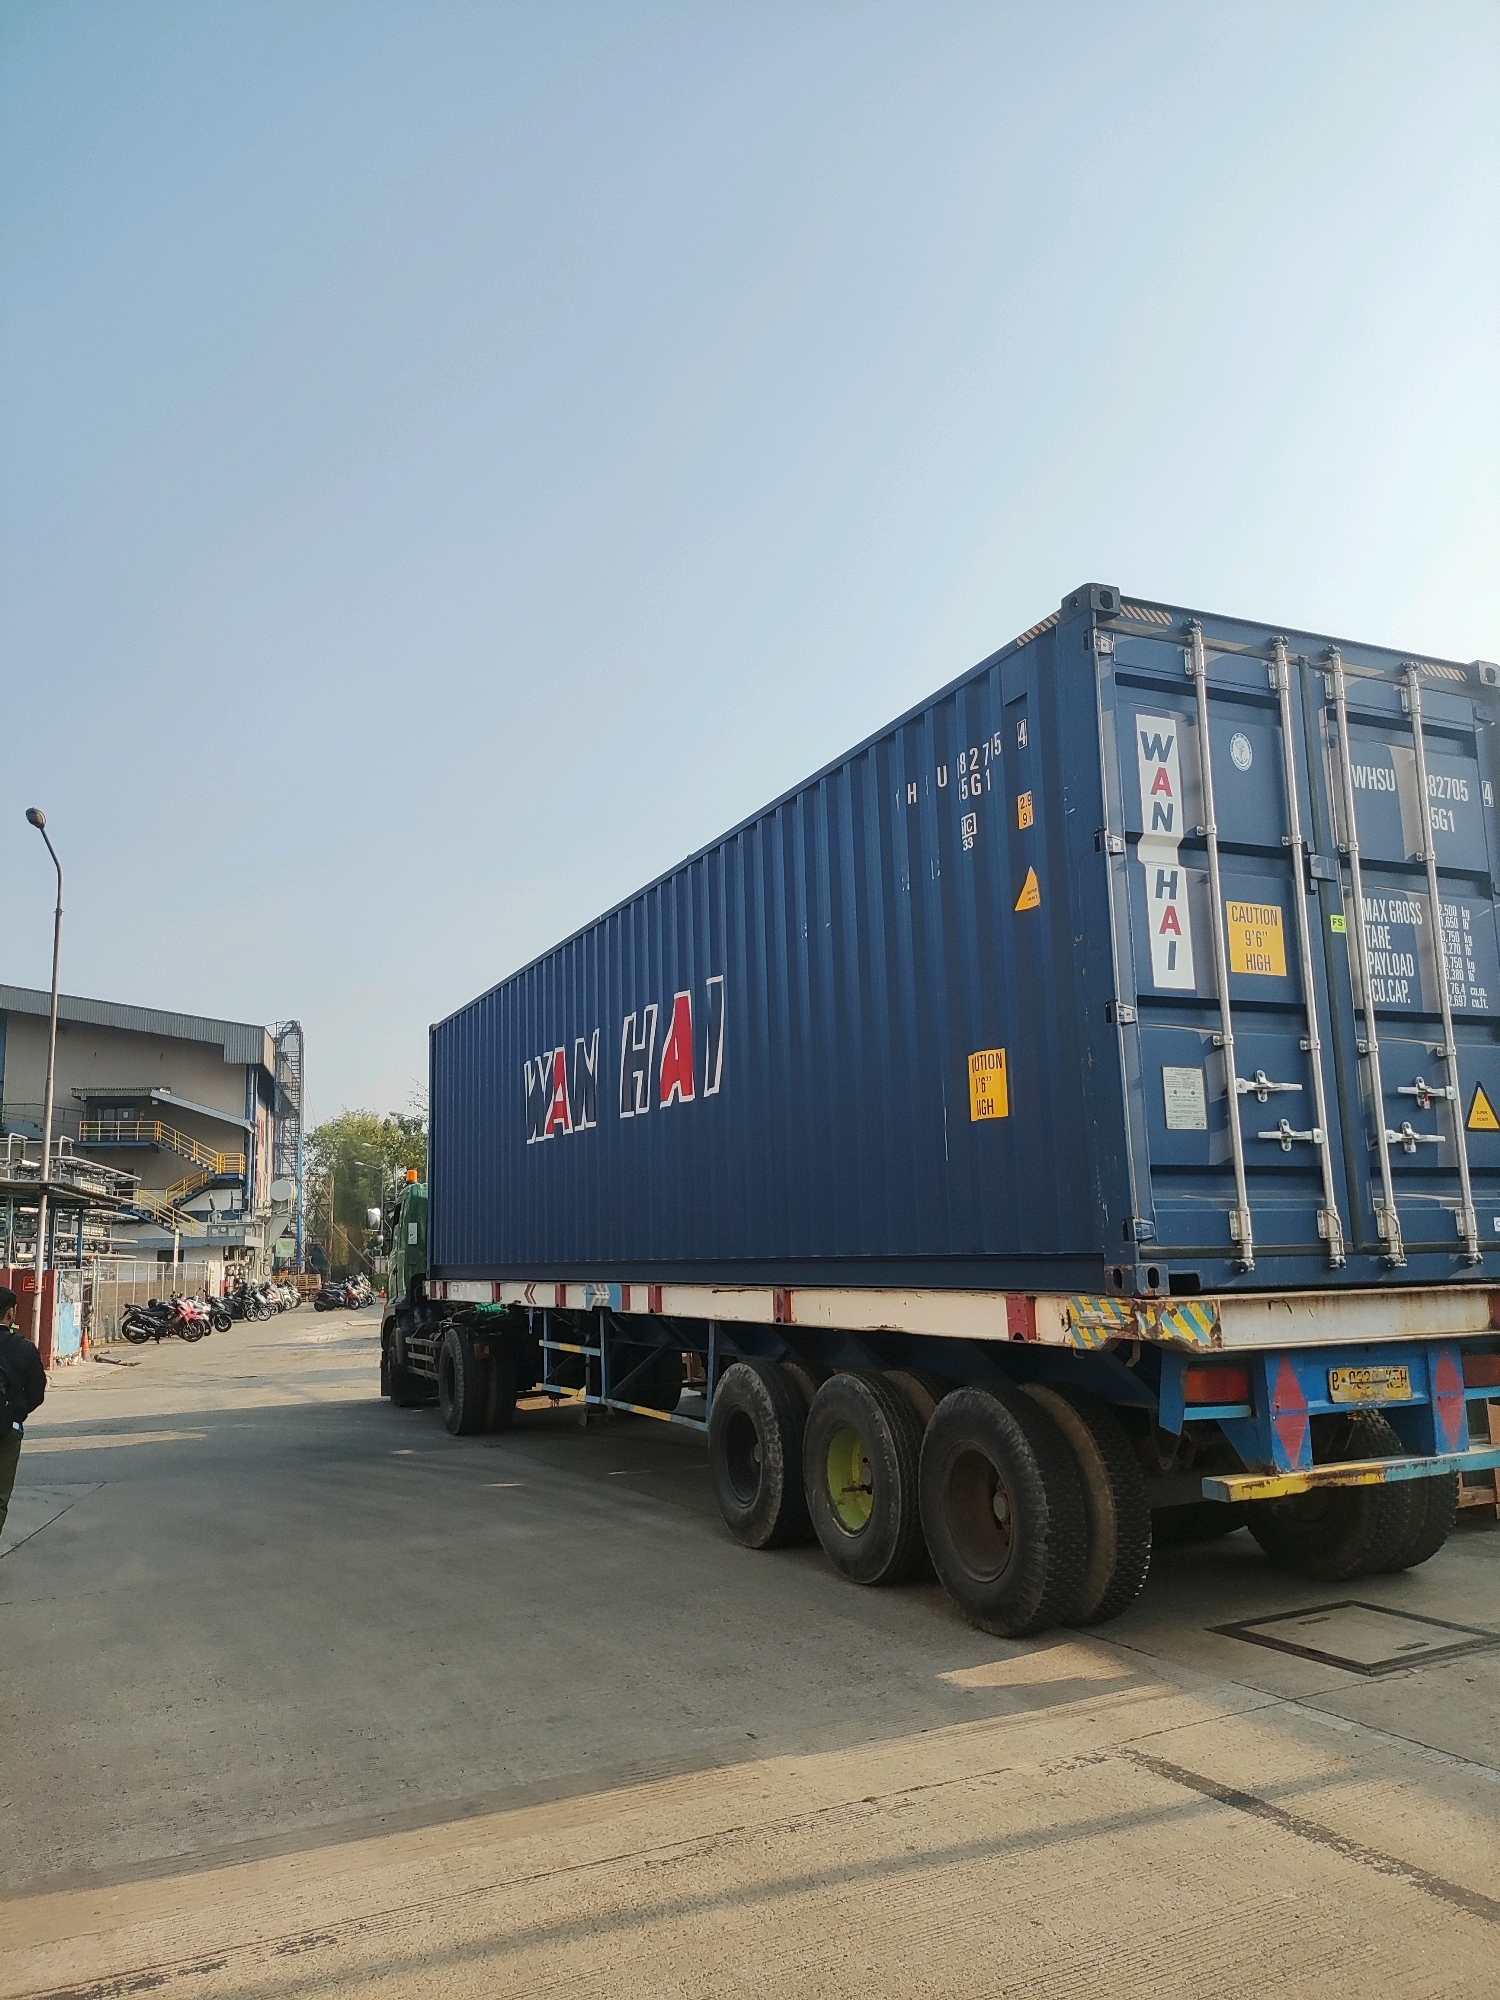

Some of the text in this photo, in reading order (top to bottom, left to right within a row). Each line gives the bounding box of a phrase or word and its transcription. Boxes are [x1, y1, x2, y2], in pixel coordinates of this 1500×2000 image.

[1018, 721, 1027, 747] 4
[958, 768, 991, 802] 5G1
[1351, 765, 1396, 791] WHSU
[1426, 774, 1469, 802] 82705
[1430, 807, 1455, 832] 5G1
[963, 837, 974, 851] 33
[1139, 731, 1182, 971] WAN HAI
[1231, 905, 1278, 927] CAUTION
[1332, 918, 1343, 927] FS
[1362, 898, 1422, 925] MAX GROSS
[1461, 906, 1470, 921] kg
[1365, 925, 1392, 949] TARE
[1464, 932, 1473, 947] kg
[1245, 953, 1271, 971] HIGH
[1367, 951, 1414, 977] PAYLOAD
[1466, 958, 1475, 973] kg
[1371, 978, 1411, 1004] CU.CAP.
[1450, 982, 1466, 995] 76.4
[524, 1028, 600, 1145] WAN
